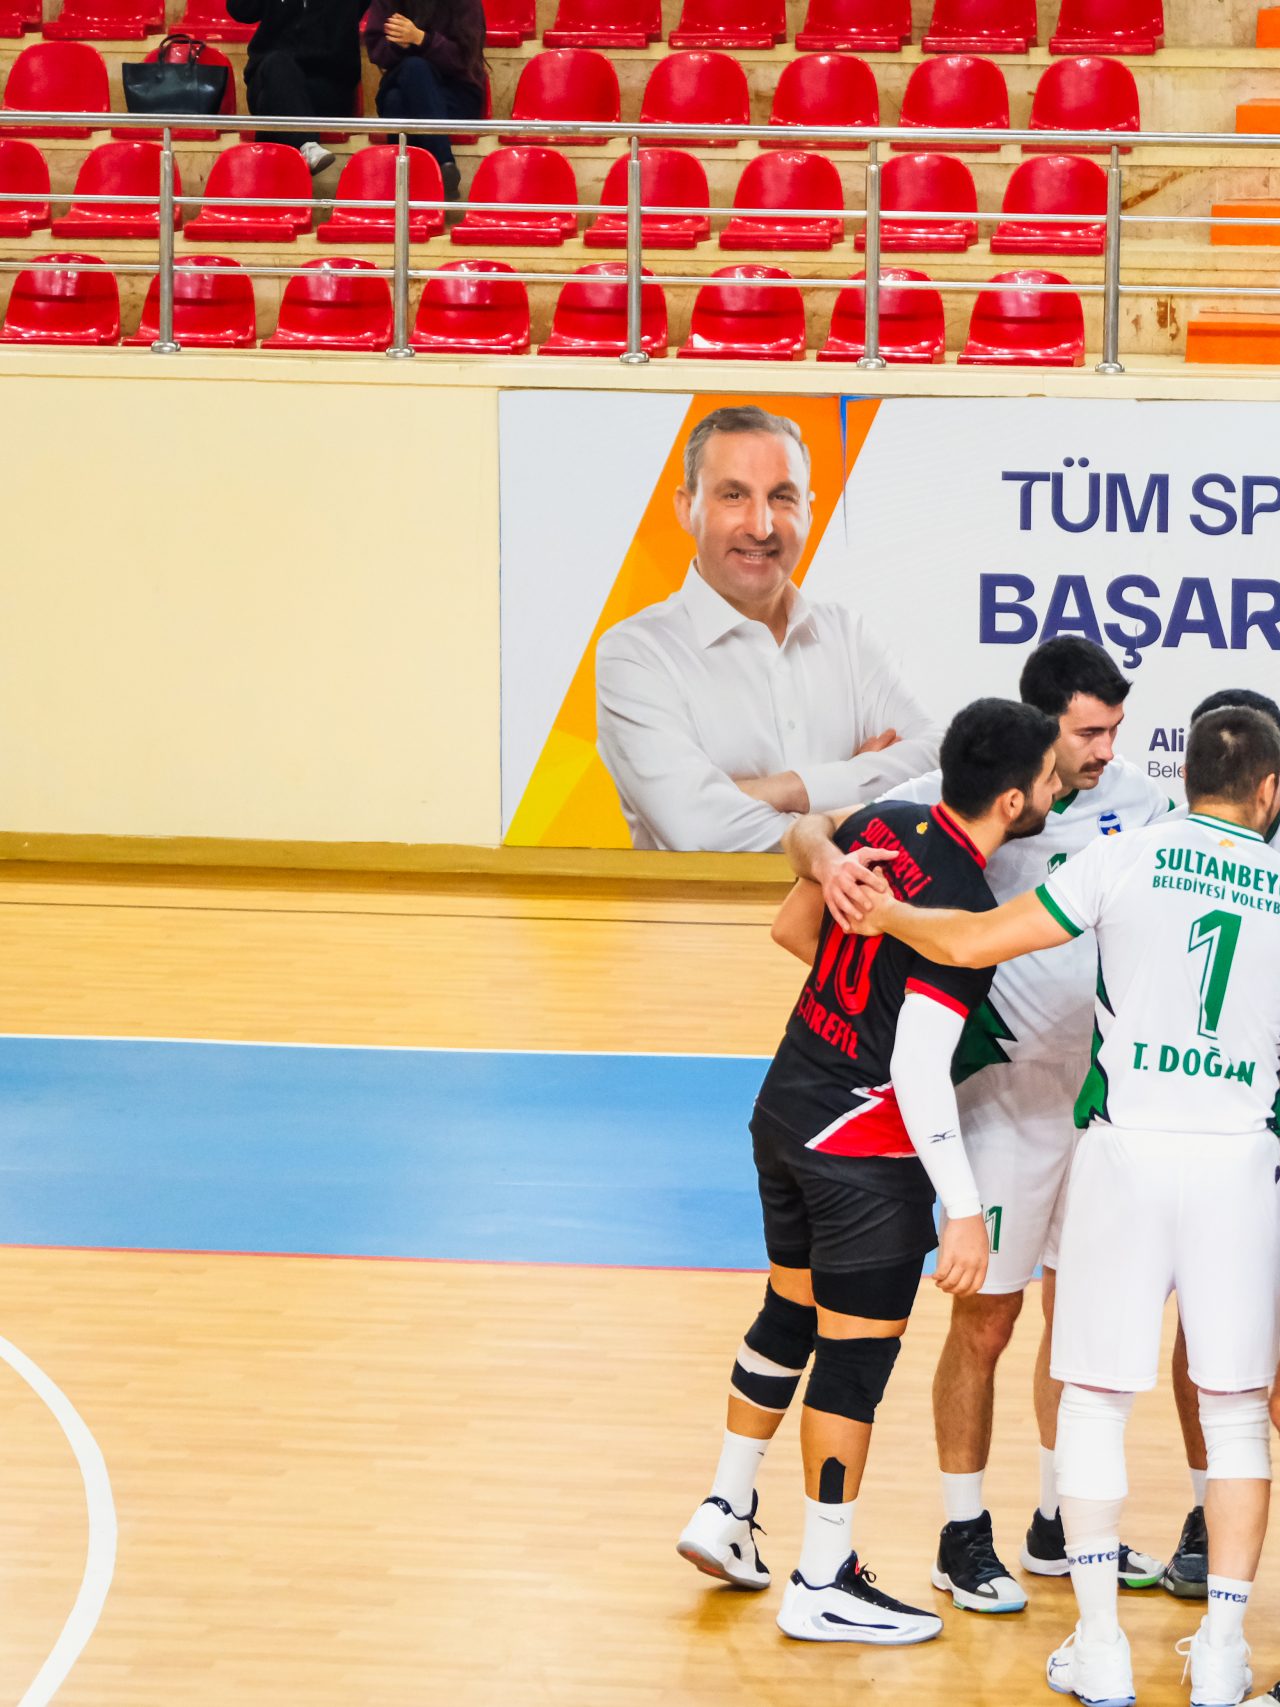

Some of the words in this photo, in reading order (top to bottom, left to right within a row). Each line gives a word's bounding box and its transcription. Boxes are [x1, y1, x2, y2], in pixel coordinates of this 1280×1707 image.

[1001, 457, 1169, 534] TÜM
[1148, 727, 1185, 753] Ali
[1152, 875, 1226, 901] BELEDİYESİ
[1187, 909, 1243, 1041] 1
[1133, 1042, 1149, 1071] T.
[1158, 1044, 1256, 1089] DOĞAN
